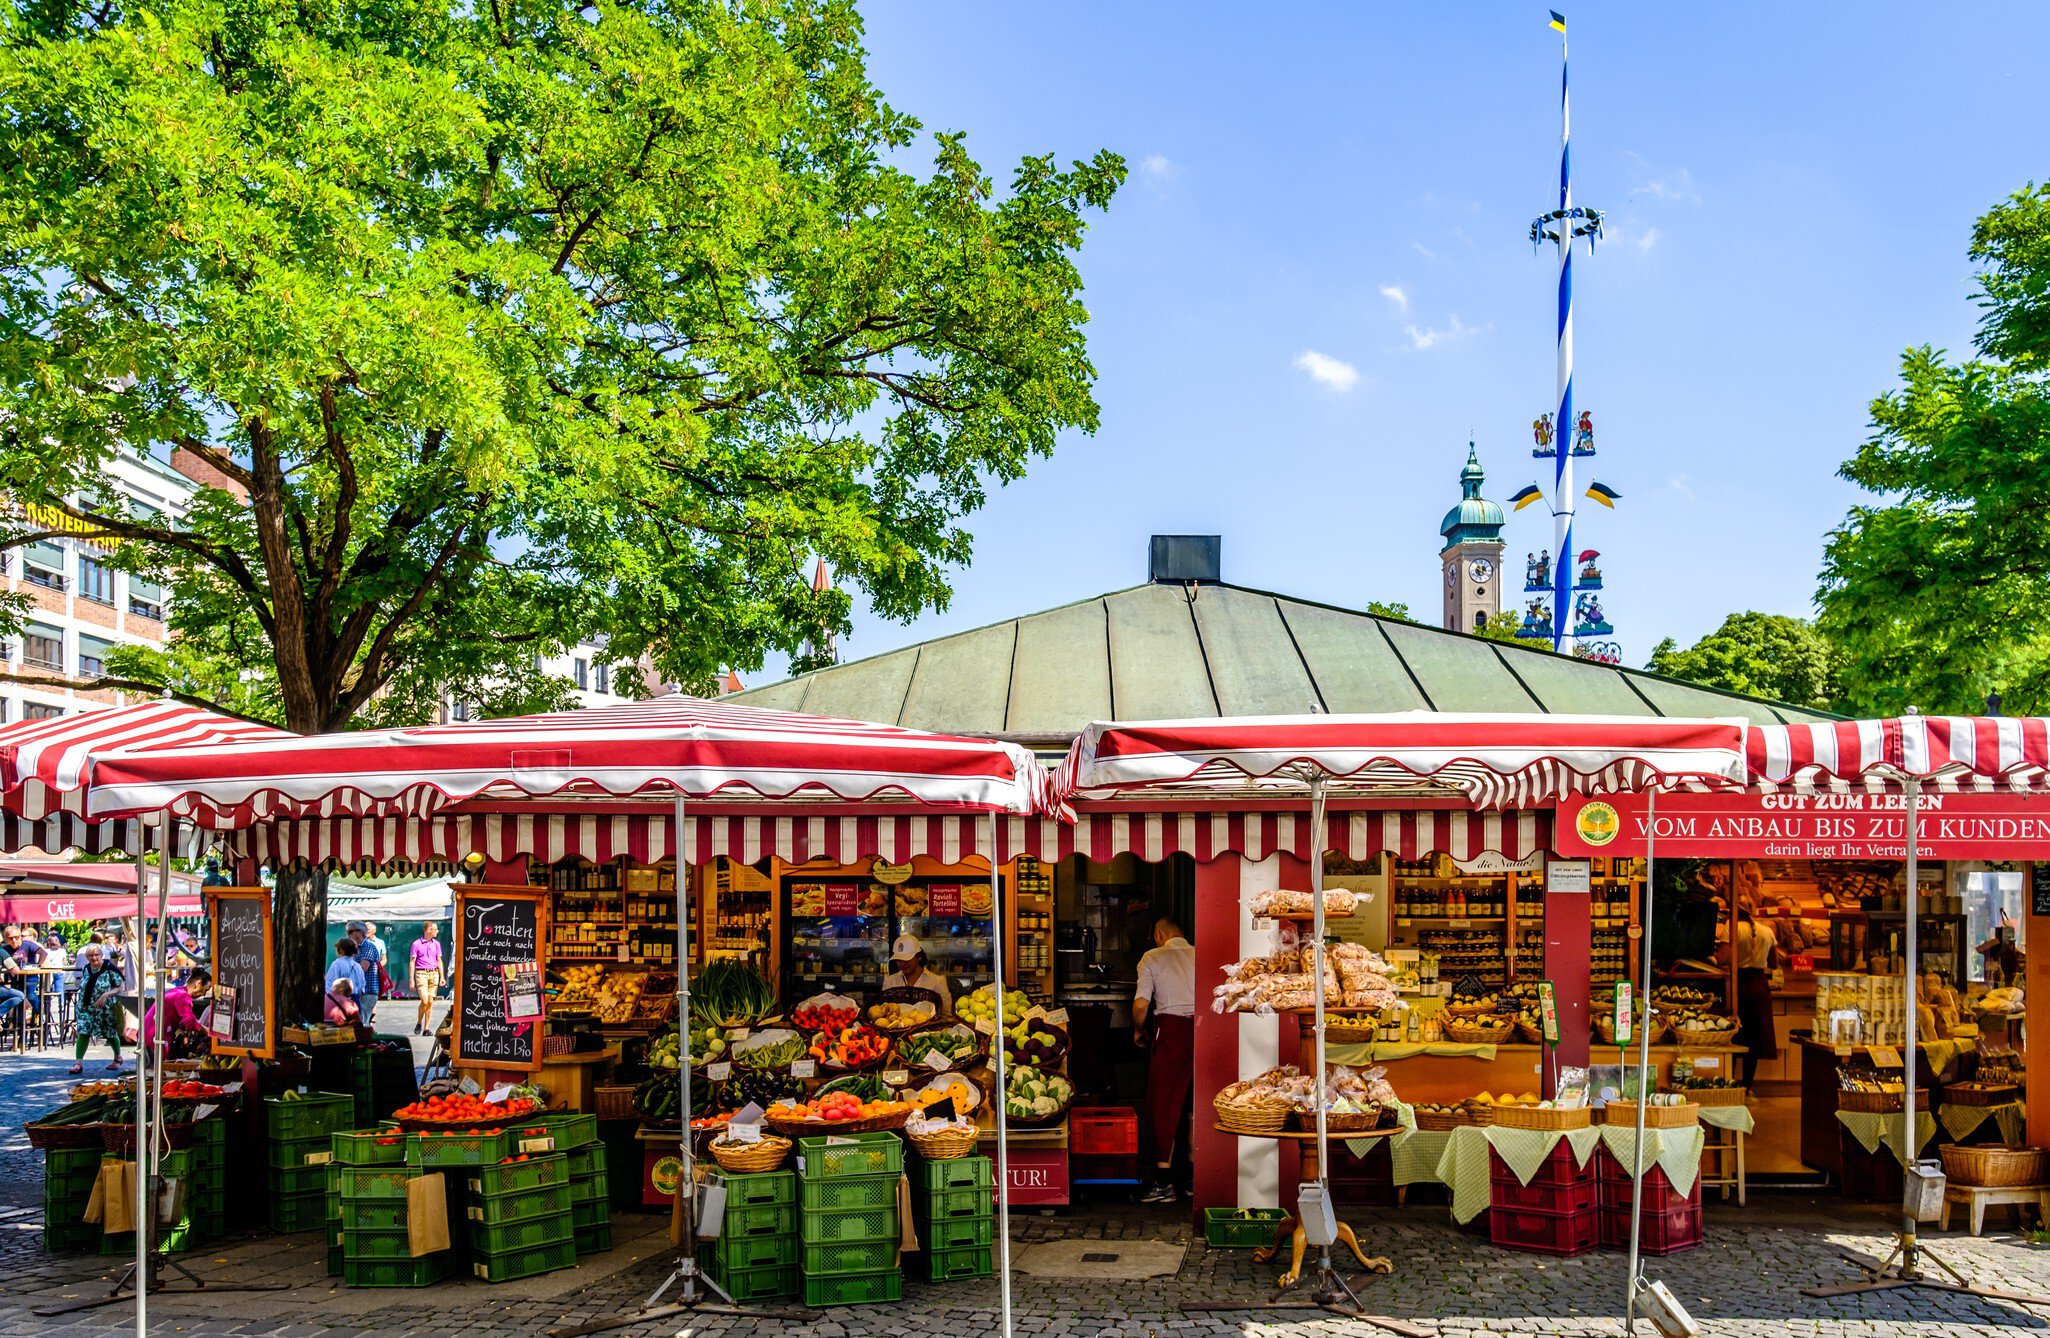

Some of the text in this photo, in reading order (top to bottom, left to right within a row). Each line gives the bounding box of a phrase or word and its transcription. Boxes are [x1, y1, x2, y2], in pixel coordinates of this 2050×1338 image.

[1761, 794, 1808, 810] GUT
[1815, 794, 1863, 810] ZUM
[1635, 817, 1697, 837] VOM
[1708, 817, 1803, 838] ANBAU
[1815, 818, 1856, 838] BIS
[1939, 818, 2050, 839] KUNDEN
[1765, 842, 1937, 859] darin liegt Ihr Vertraen.
[1477, 860, 1492, 869] die
[221, 906, 264, 942] Angebot
[478, 937, 533, 950] die noch nach
[220, 944, 262, 970] Gurken
[465, 946, 537, 964] Tomaten schmecken
[471, 973, 503, 986] aus eige
[465, 1001, 506, 1018] Landb
[464, 1035, 532, 1058] mehr als Bio
